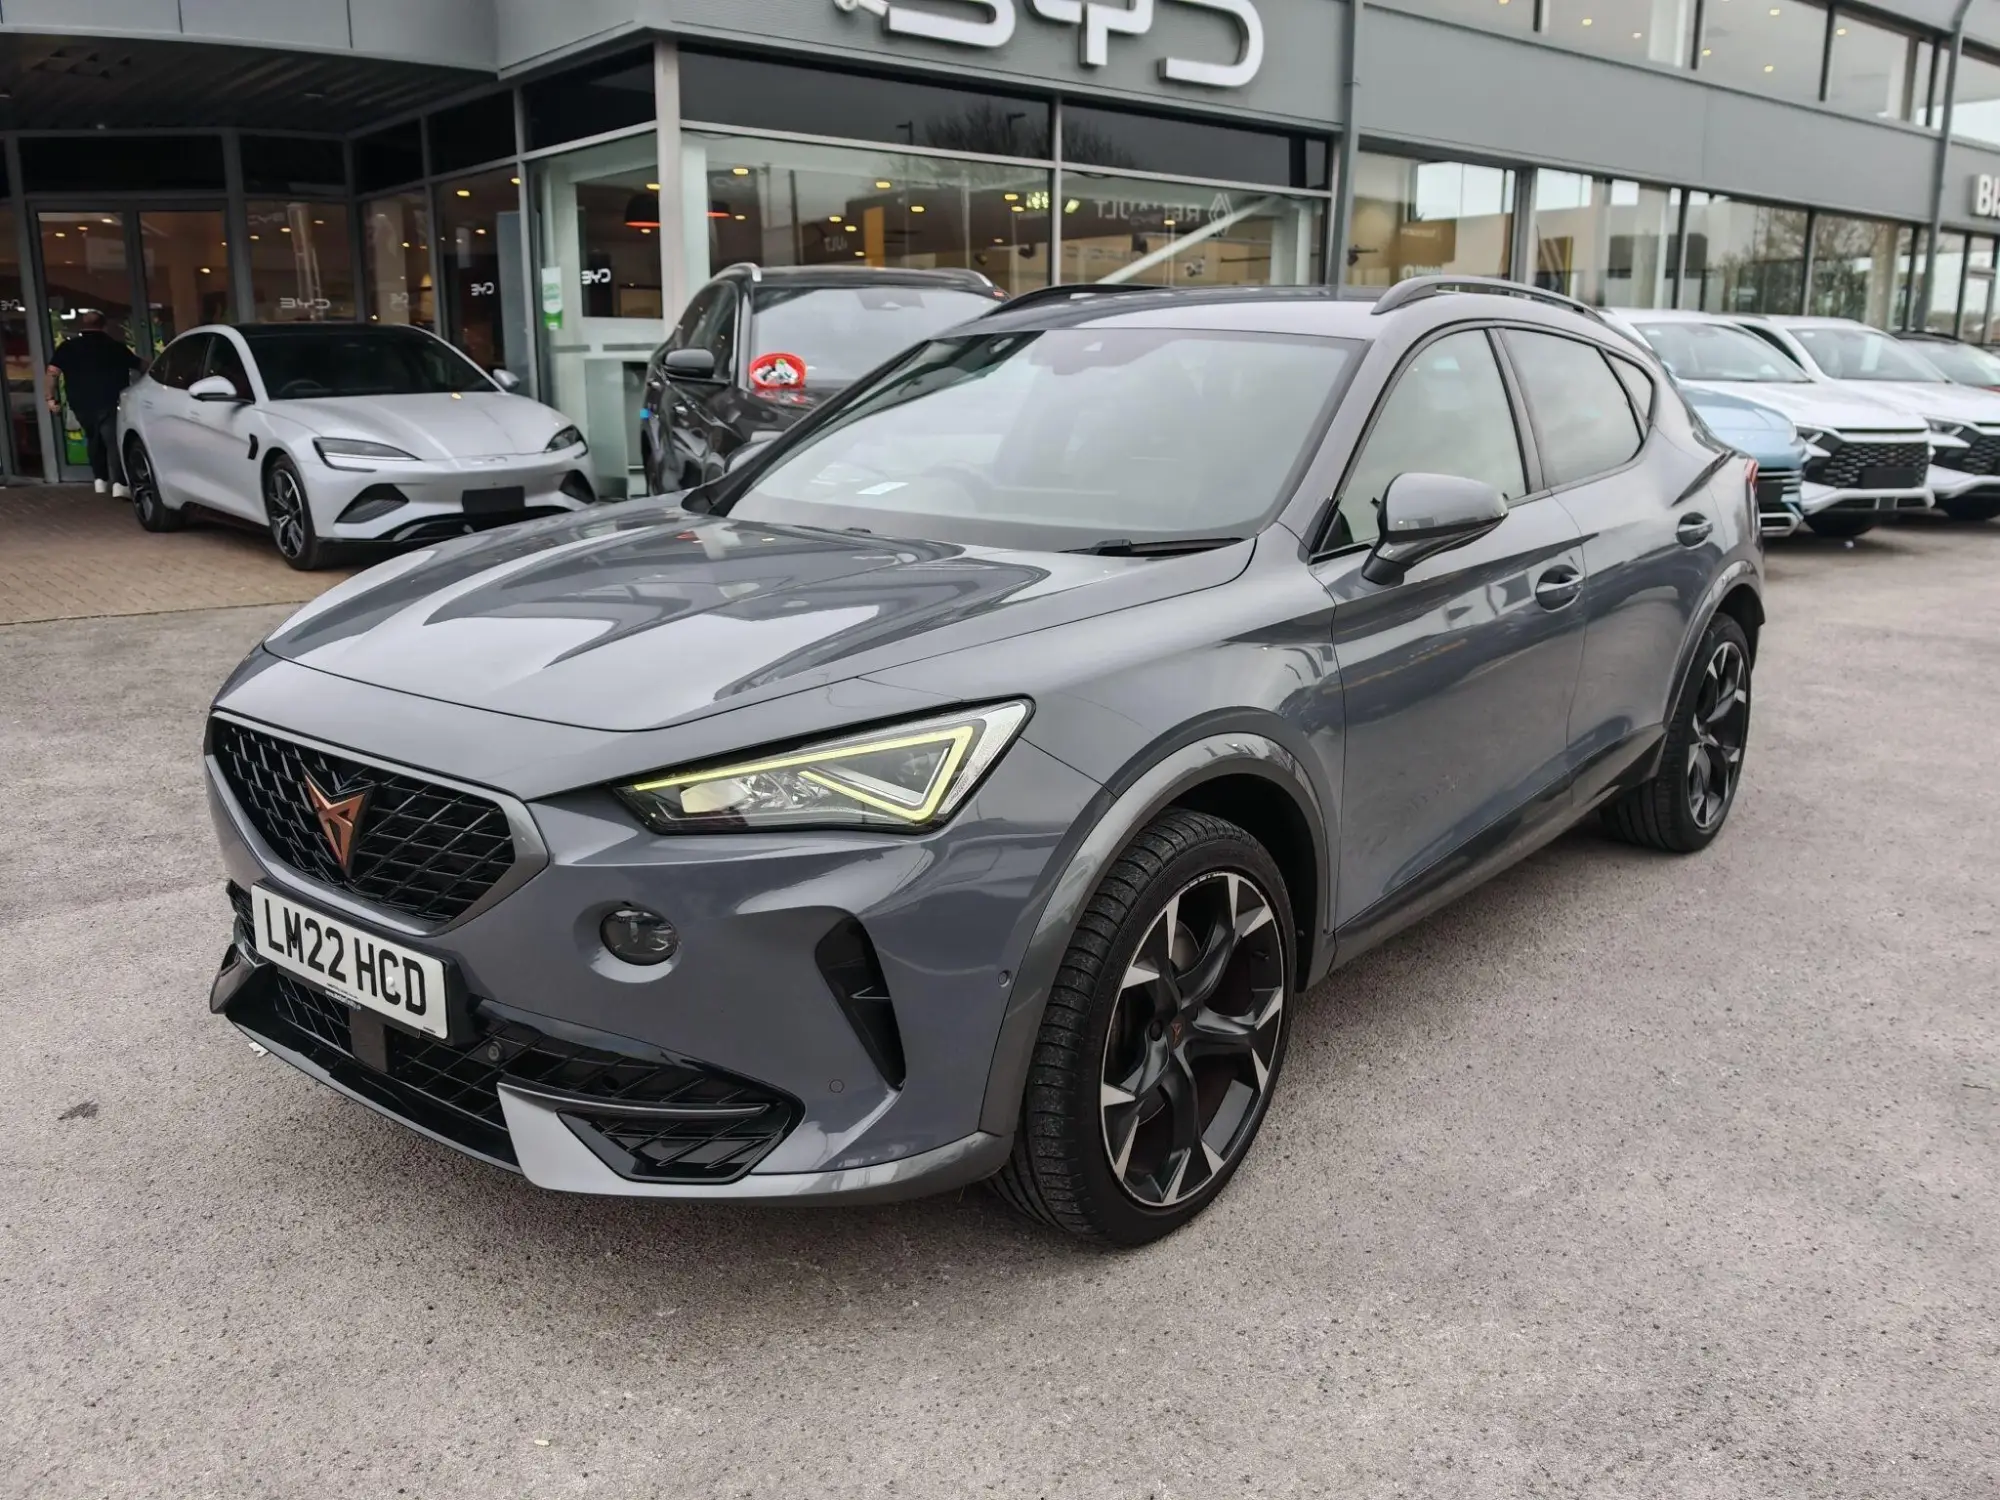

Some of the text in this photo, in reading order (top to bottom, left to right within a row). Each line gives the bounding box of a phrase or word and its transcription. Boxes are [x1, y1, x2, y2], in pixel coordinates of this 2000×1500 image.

[581, 268, 611, 285] BYD
[470, 282, 495, 296] BYD
[280, 297, 331, 309] BYD
[264, 898, 427, 1017] LM22 HCD
